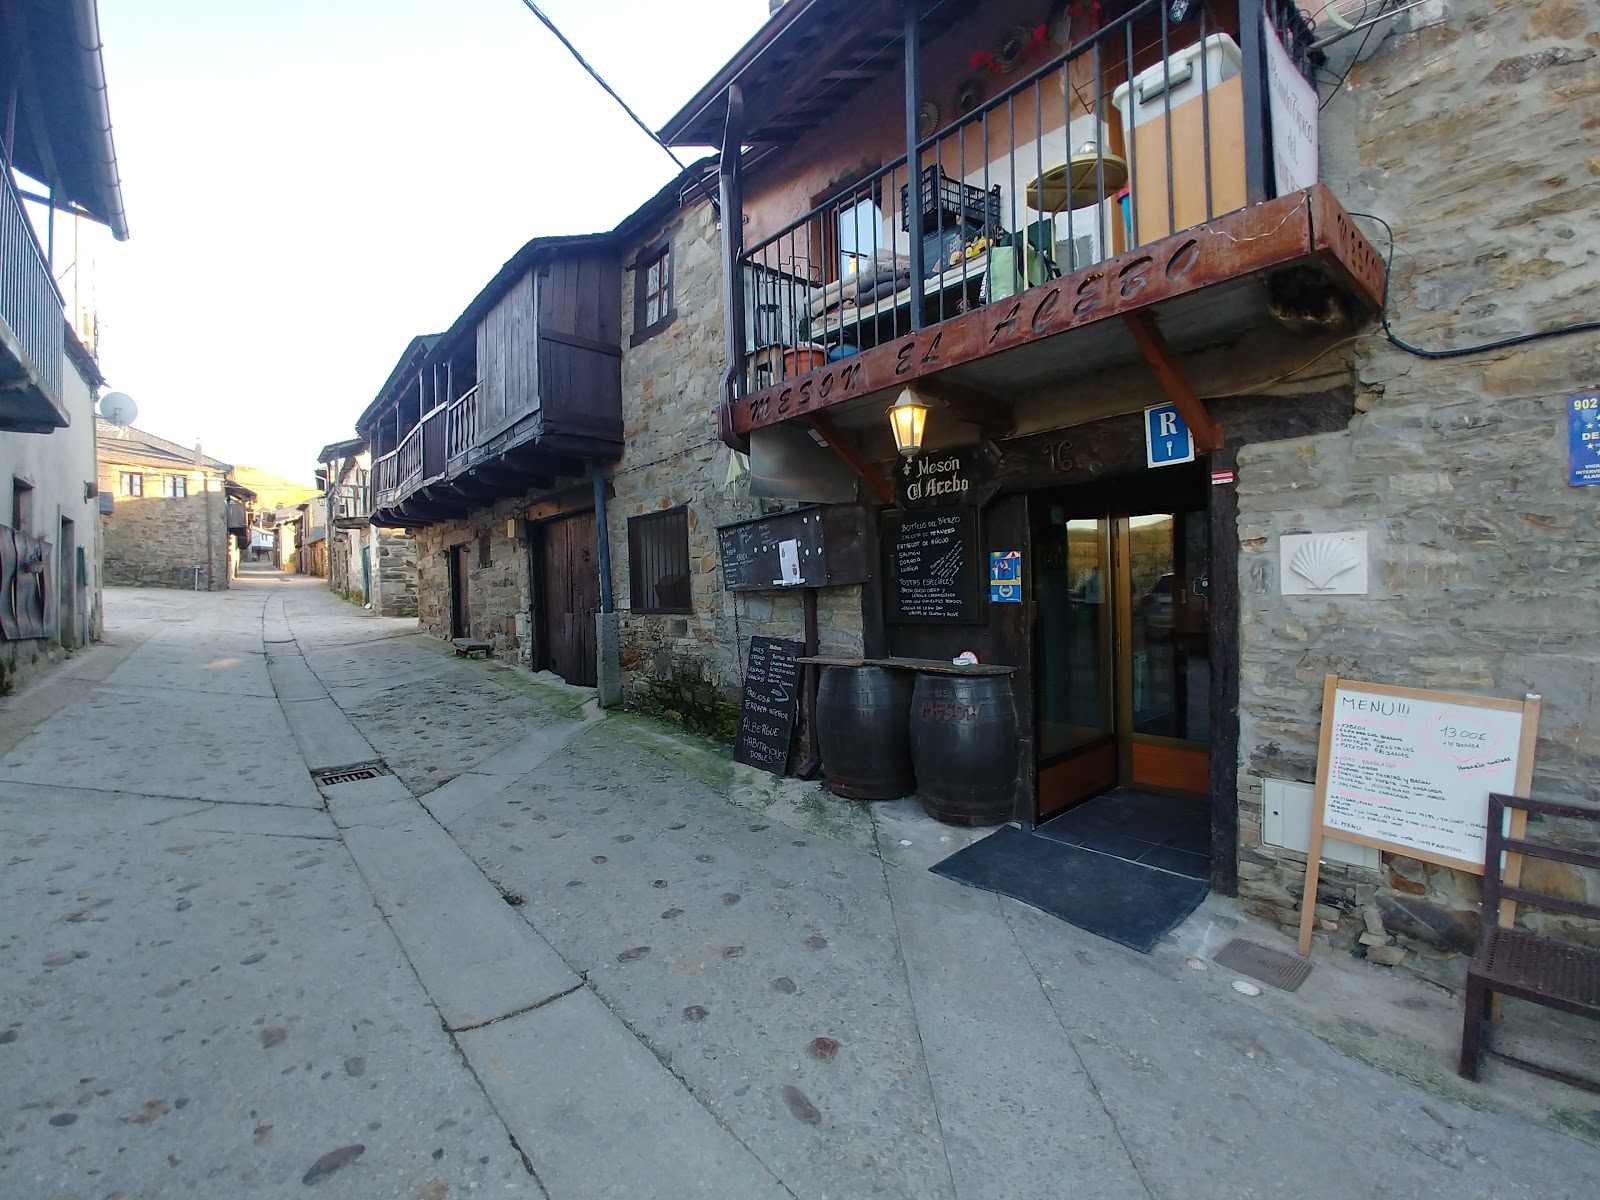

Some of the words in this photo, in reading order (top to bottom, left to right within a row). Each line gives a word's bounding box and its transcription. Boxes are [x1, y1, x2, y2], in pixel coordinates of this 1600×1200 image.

[750, 363, 861, 423] MESON
[896, 331, 942, 376] EL
[989, 239, 1200, 344] ACEBO
[1574, 398, 1598, 411] 902
[1159, 411, 1178, 437] R
[917, 456, 960, 478] Mesón
[924, 471, 970, 498] Acebo
[930, 527, 956, 536] TERNERA
[899, 557, 921, 566] DORADA
[746, 686, 771, 704] PRECIOSA
[744, 699, 768, 713] TERRAZA
[742, 716, 780, 737] ALBERGUE
[1340, 742, 1368, 751] PATATAS
[749, 750, 773, 764] DOBLES
[1340, 820, 1362, 831] MENU
